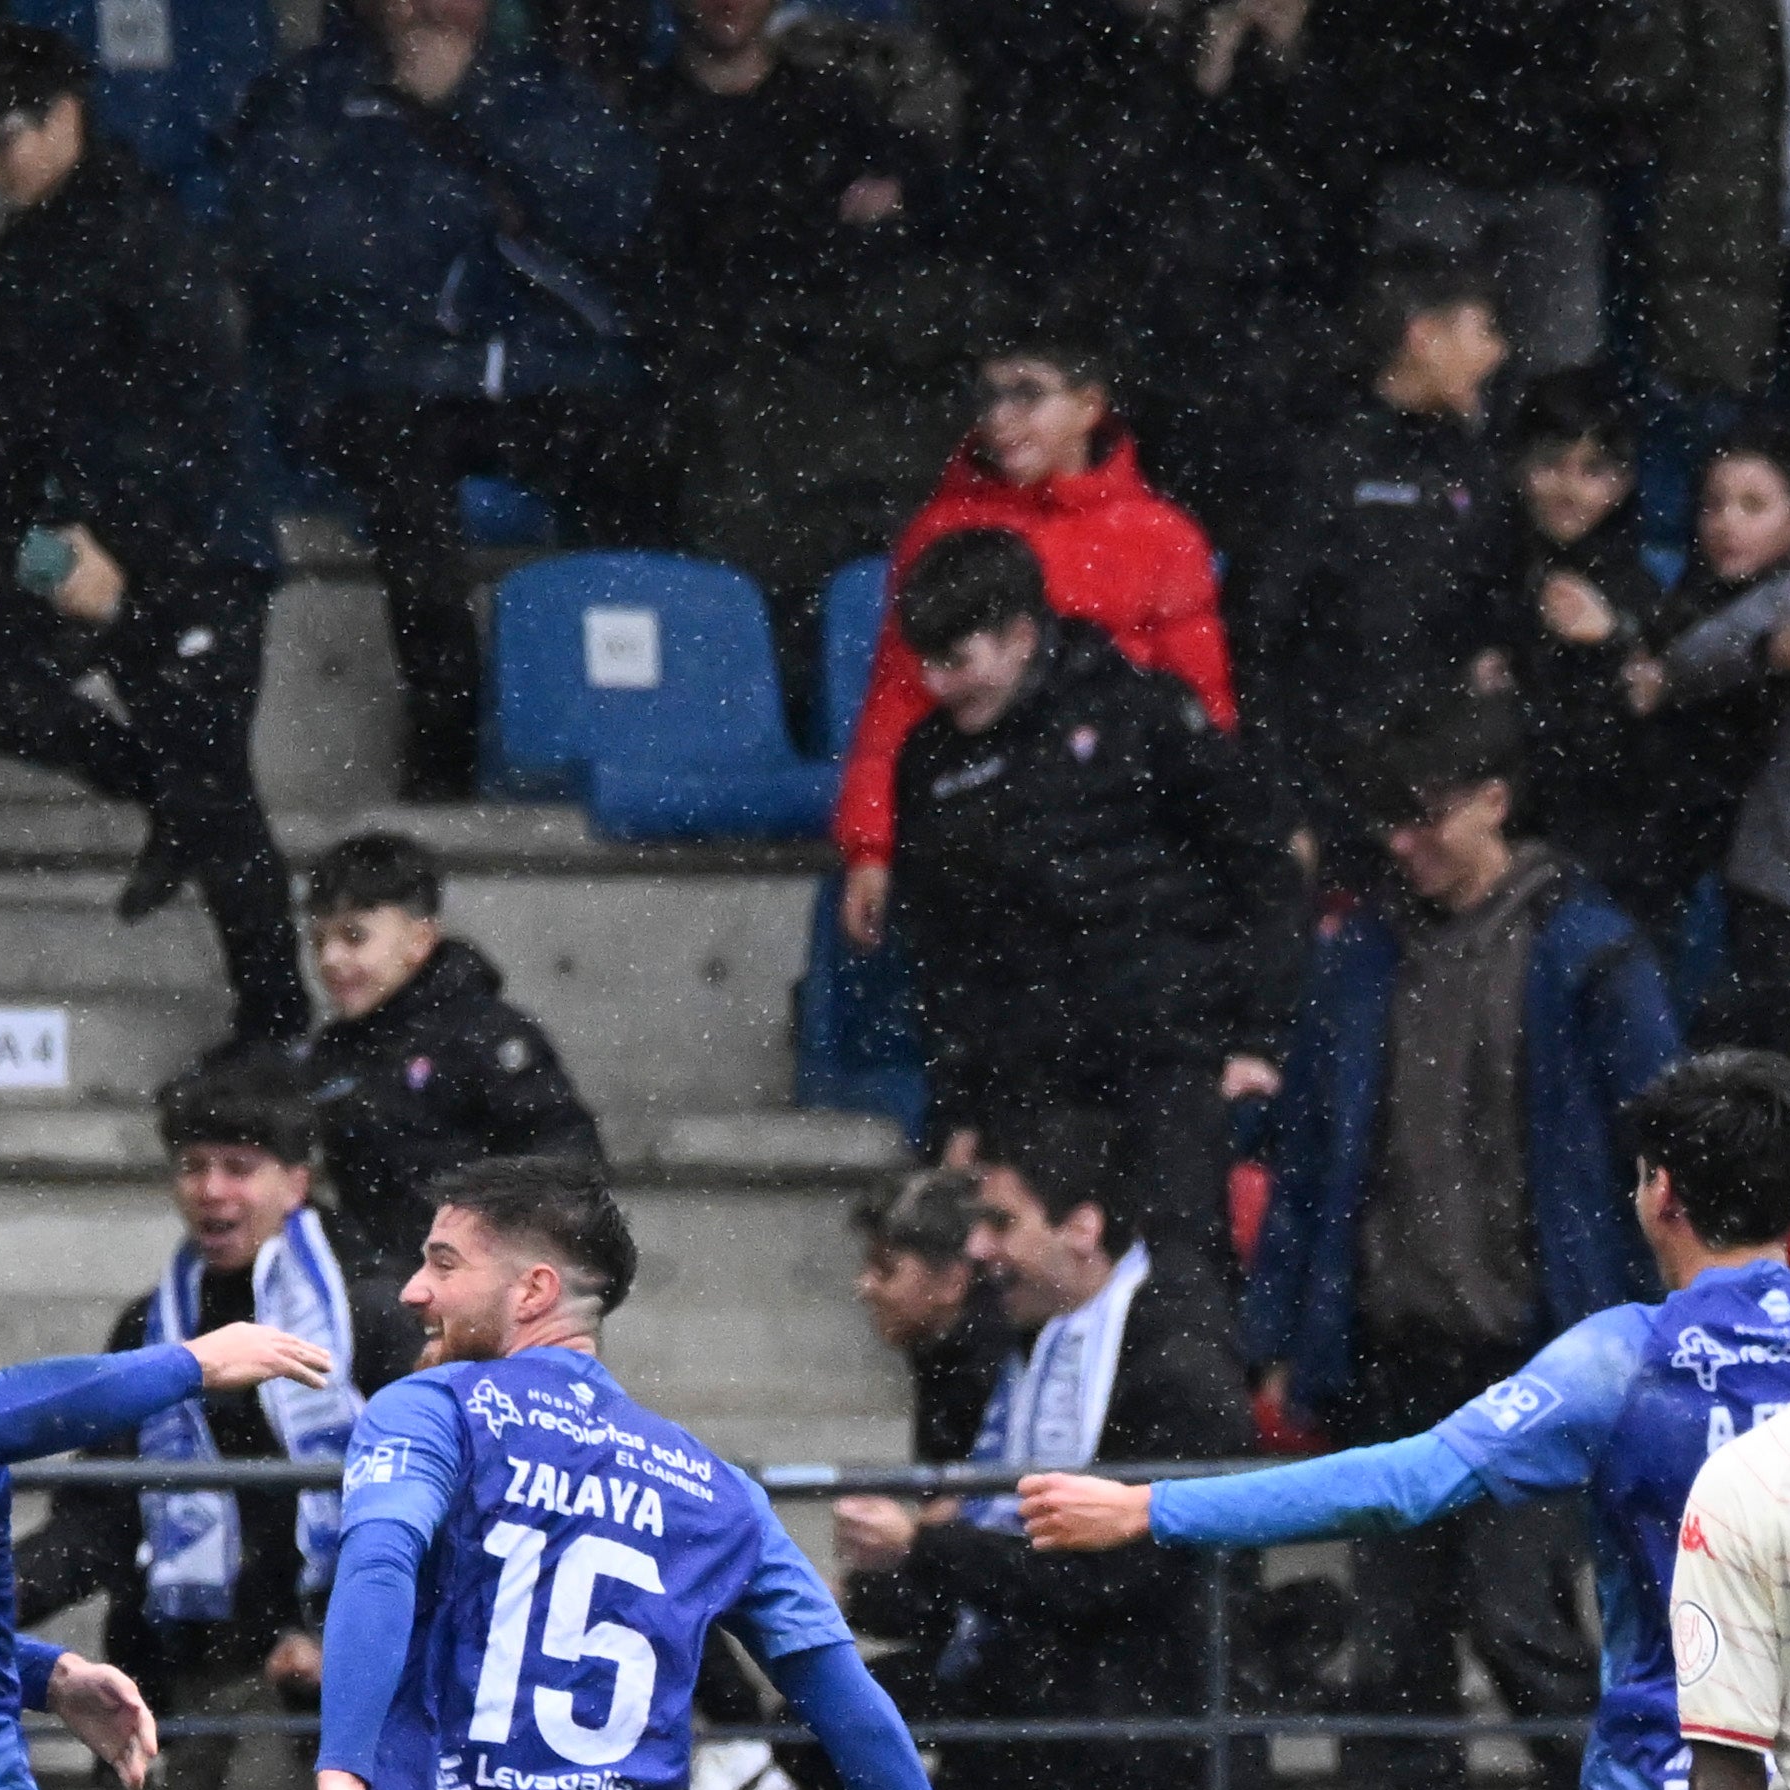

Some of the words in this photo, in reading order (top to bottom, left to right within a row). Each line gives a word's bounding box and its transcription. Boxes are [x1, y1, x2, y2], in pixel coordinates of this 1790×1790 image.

[32, 1028, 53, 1064] 4
[615, 1450, 640, 1470] EL
[642, 1460, 713, 1503] CARMEN
[651, 1443, 711, 1482] salud
[504, 1455, 664, 1538] ZALAYA
[468, 1523, 666, 1767] 15
